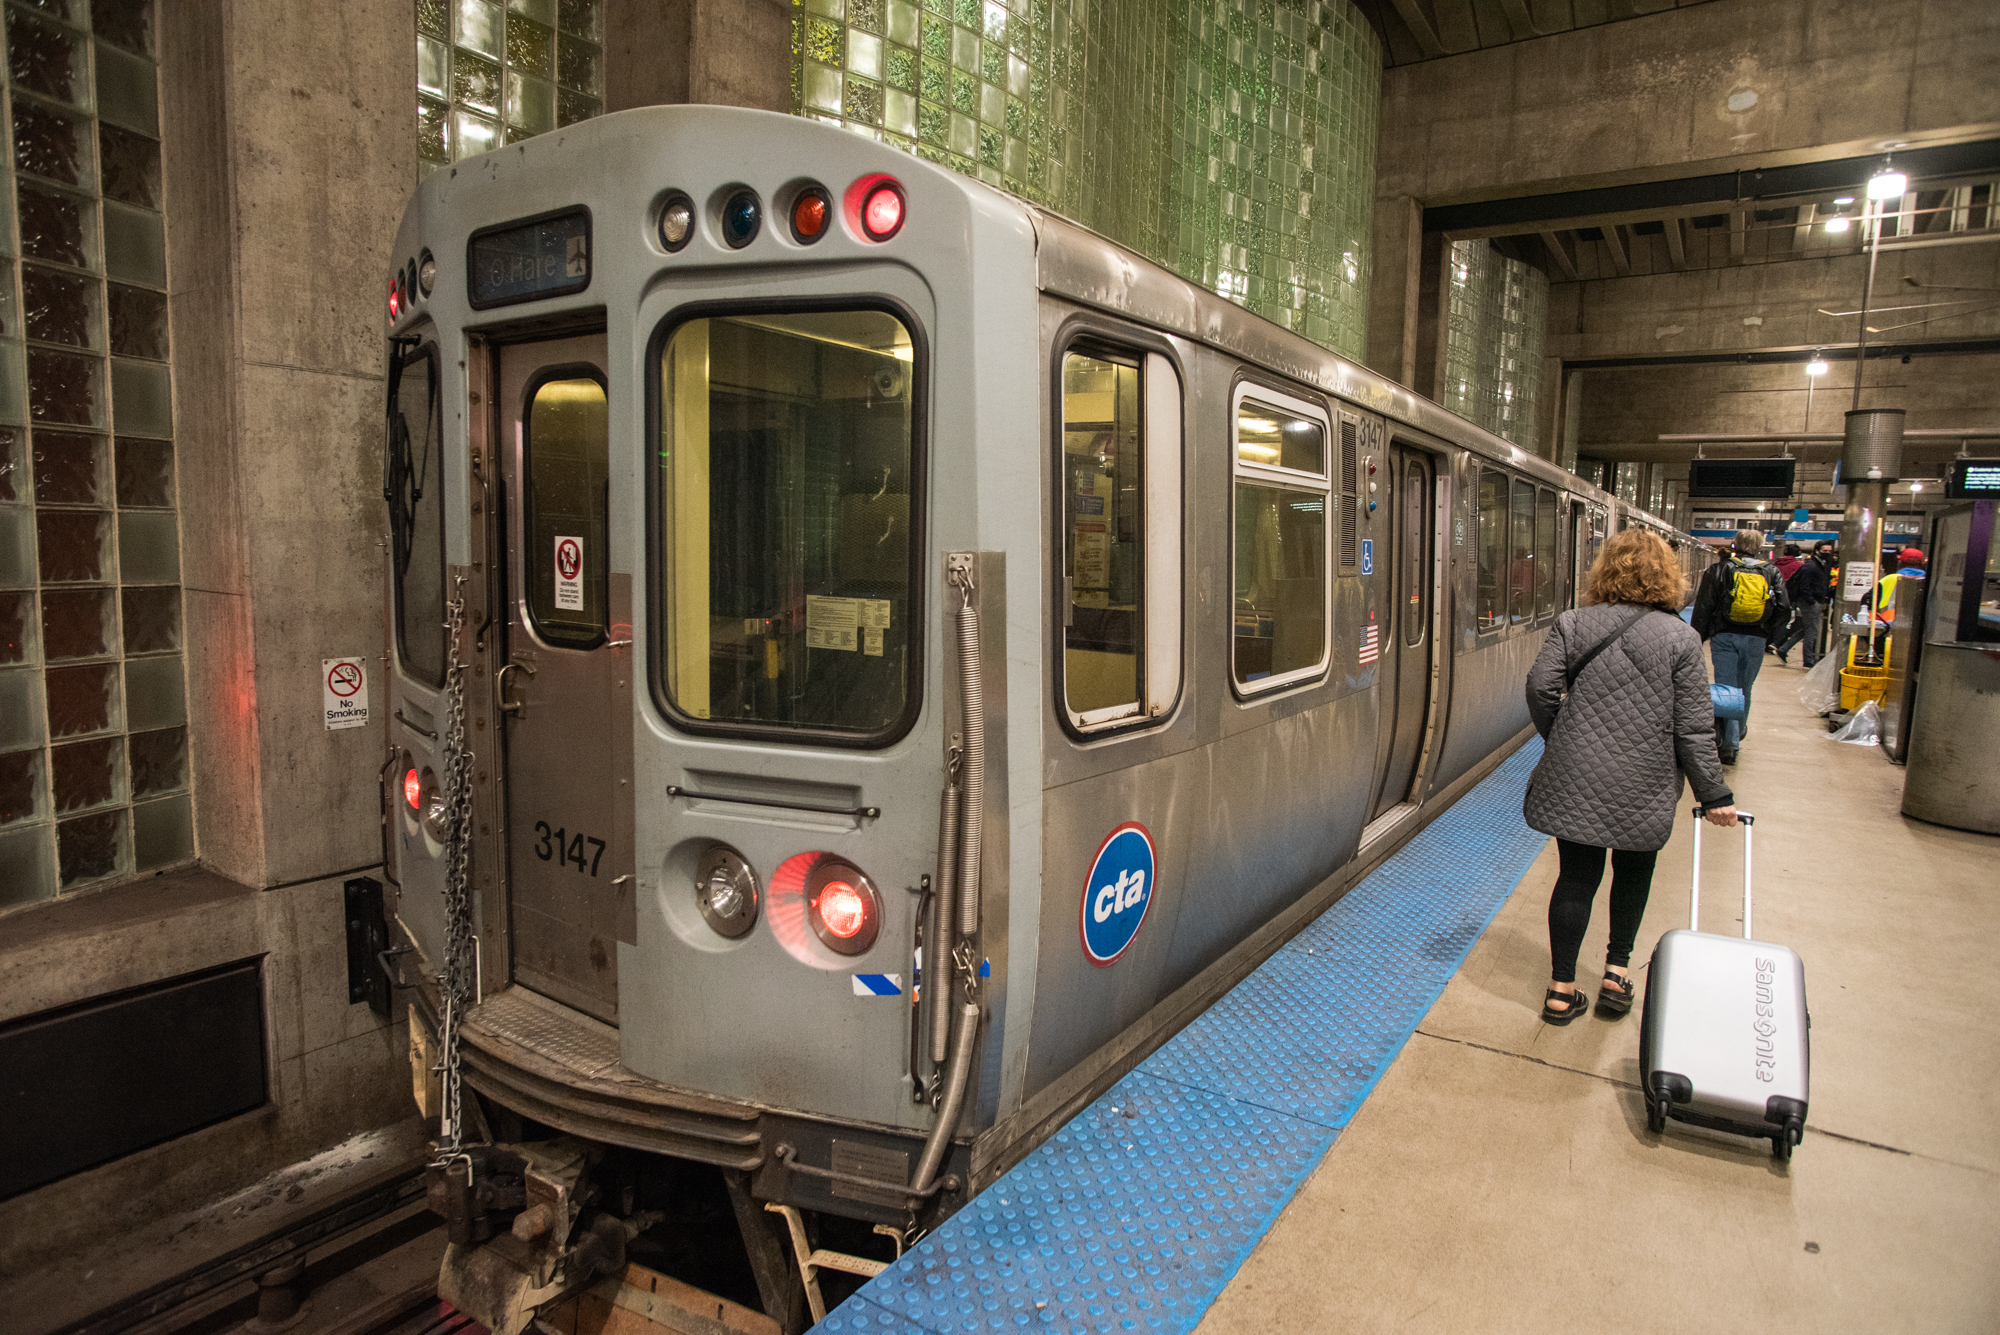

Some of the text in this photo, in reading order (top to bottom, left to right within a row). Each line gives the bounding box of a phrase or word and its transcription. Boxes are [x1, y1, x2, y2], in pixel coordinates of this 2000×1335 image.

[1359, 416, 1383, 451] 3147
[327, 708, 367, 719] Smoking
[340, 700, 353, 708] No
[534, 820, 606, 877] 3147
[1093, 869, 1146, 923] cta
[1754, 957, 1776, 1082] Samsonite
